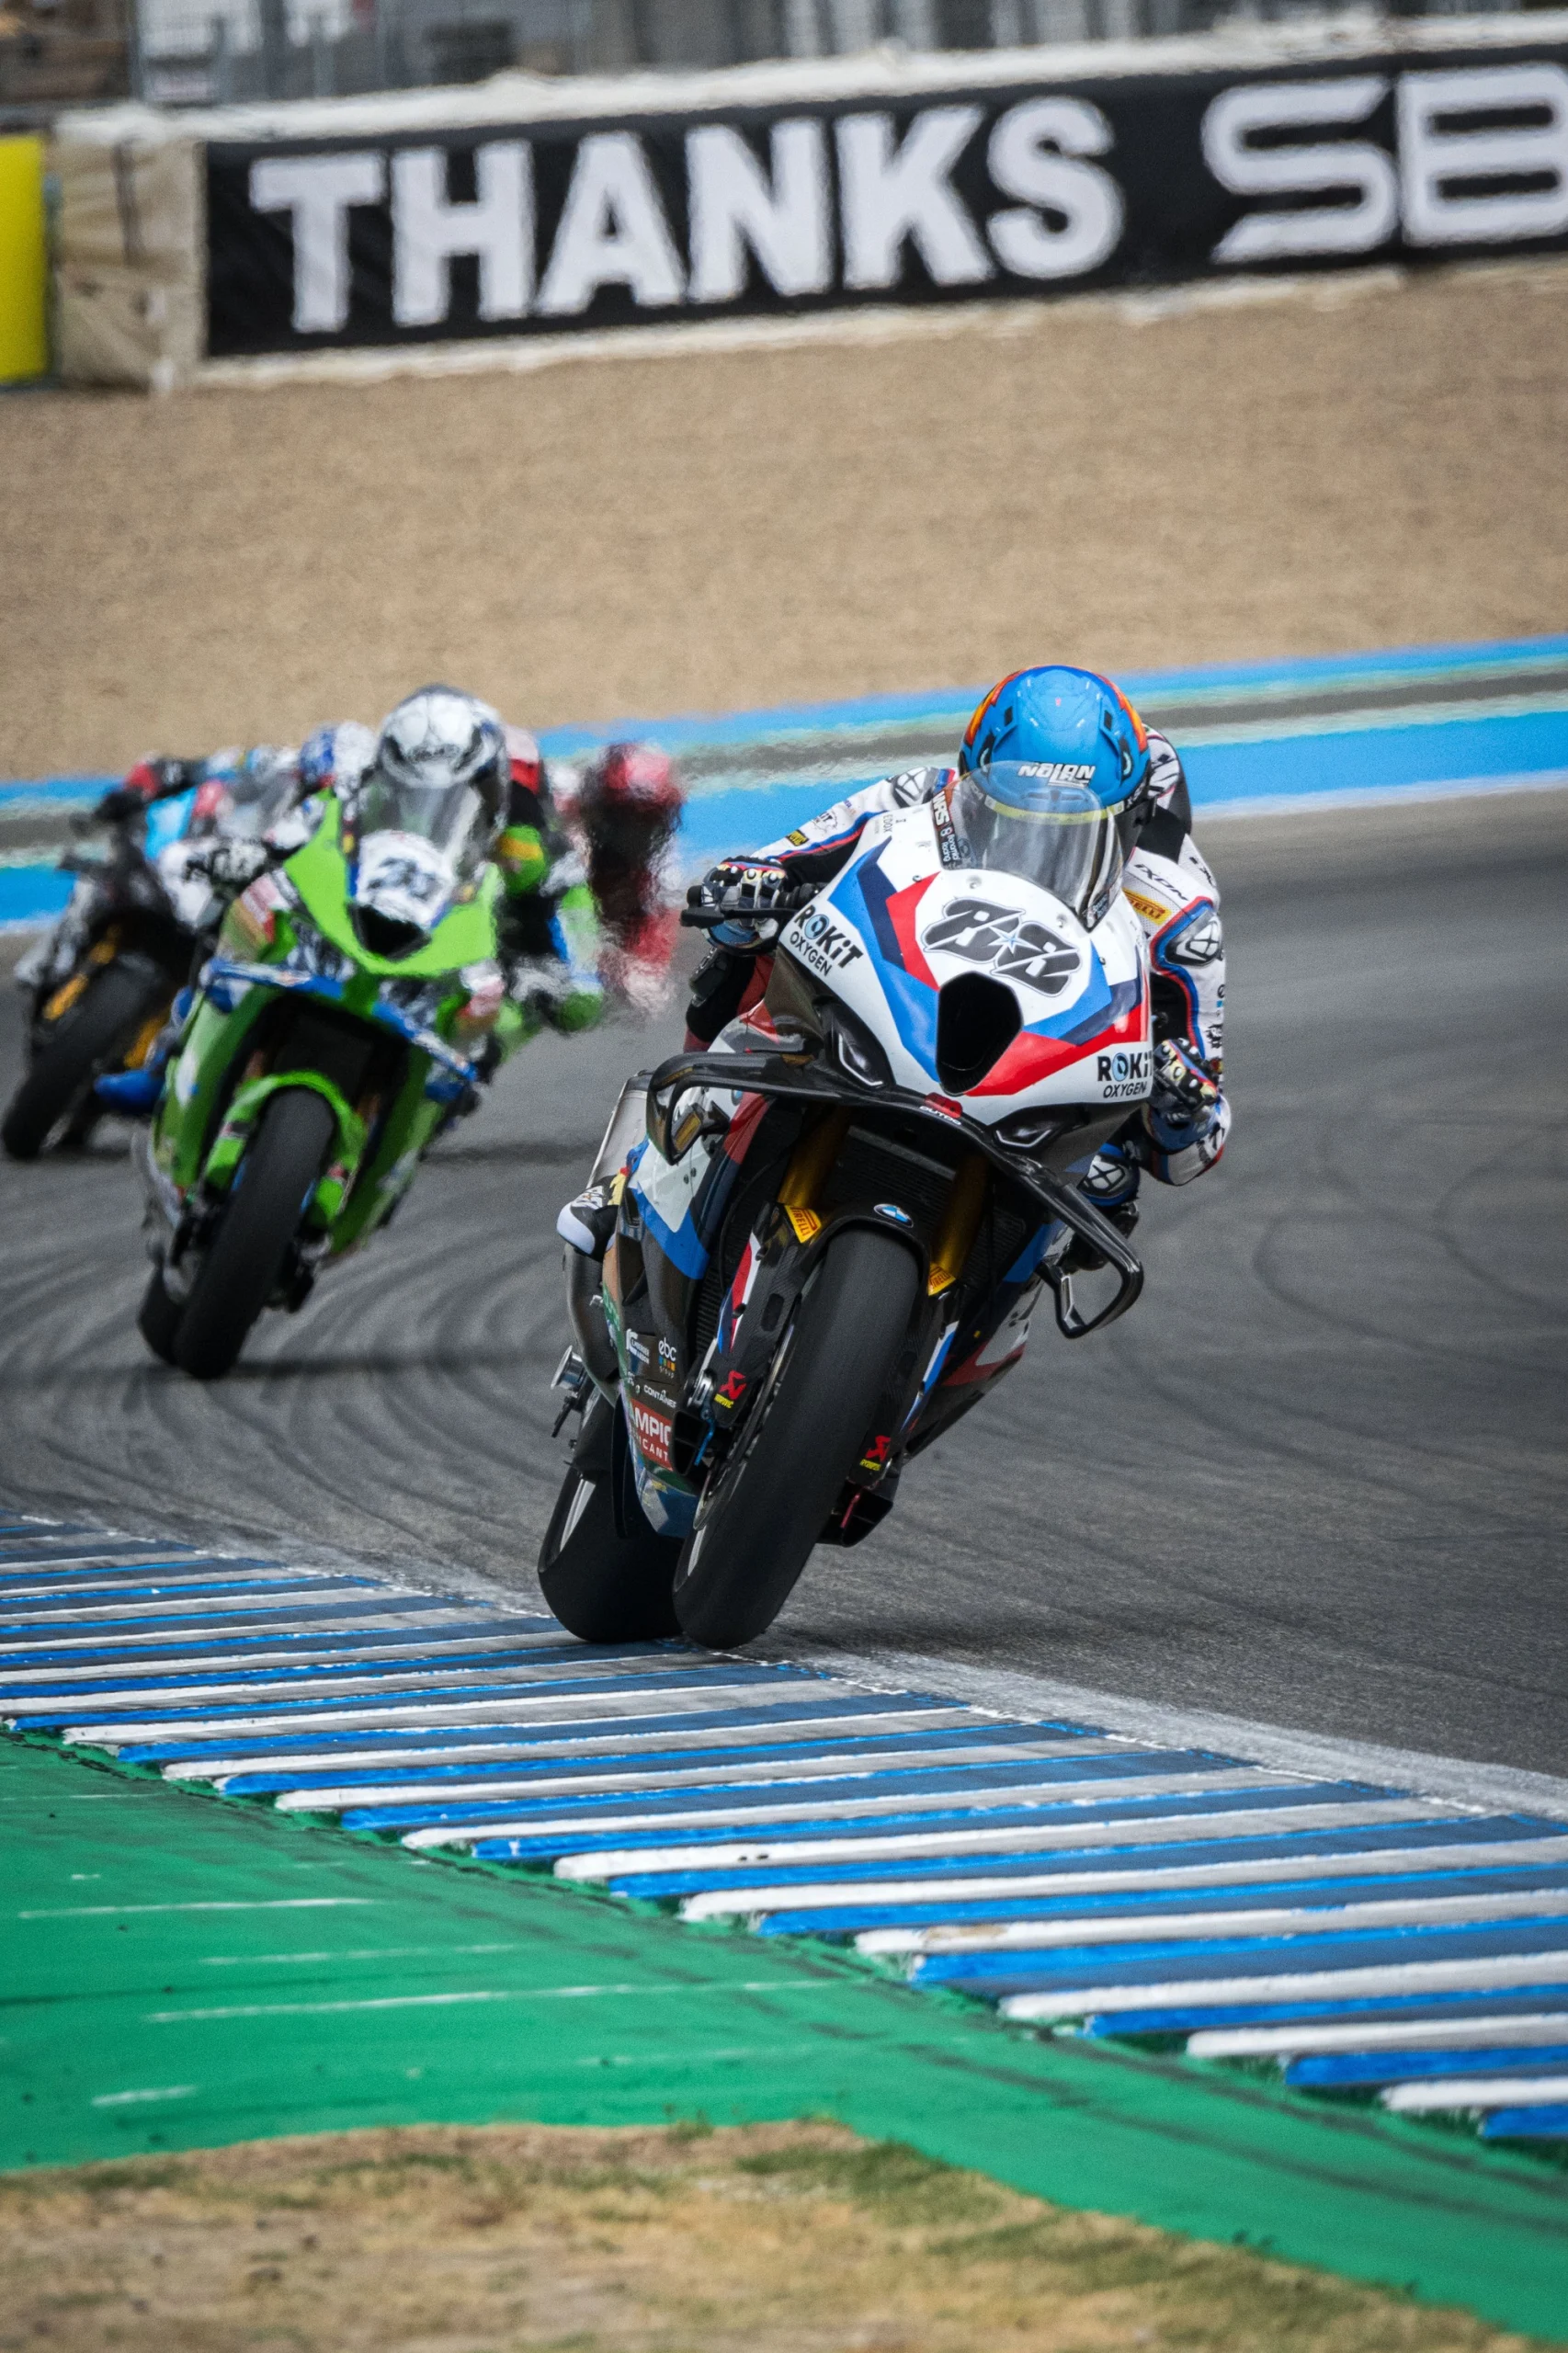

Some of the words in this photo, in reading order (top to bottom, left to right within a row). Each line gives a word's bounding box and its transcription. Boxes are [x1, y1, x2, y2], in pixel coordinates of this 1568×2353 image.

[249, 95, 1123, 334] THANKS
[1017, 762, 1096, 788] NOLAN
[932, 790, 950, 826] WRS
[790, 931, 833, 977] OXYGEN
[1103, 1081, 1147, 1098] OXYGEN
[658, 1336, 676, 1361] ebc
